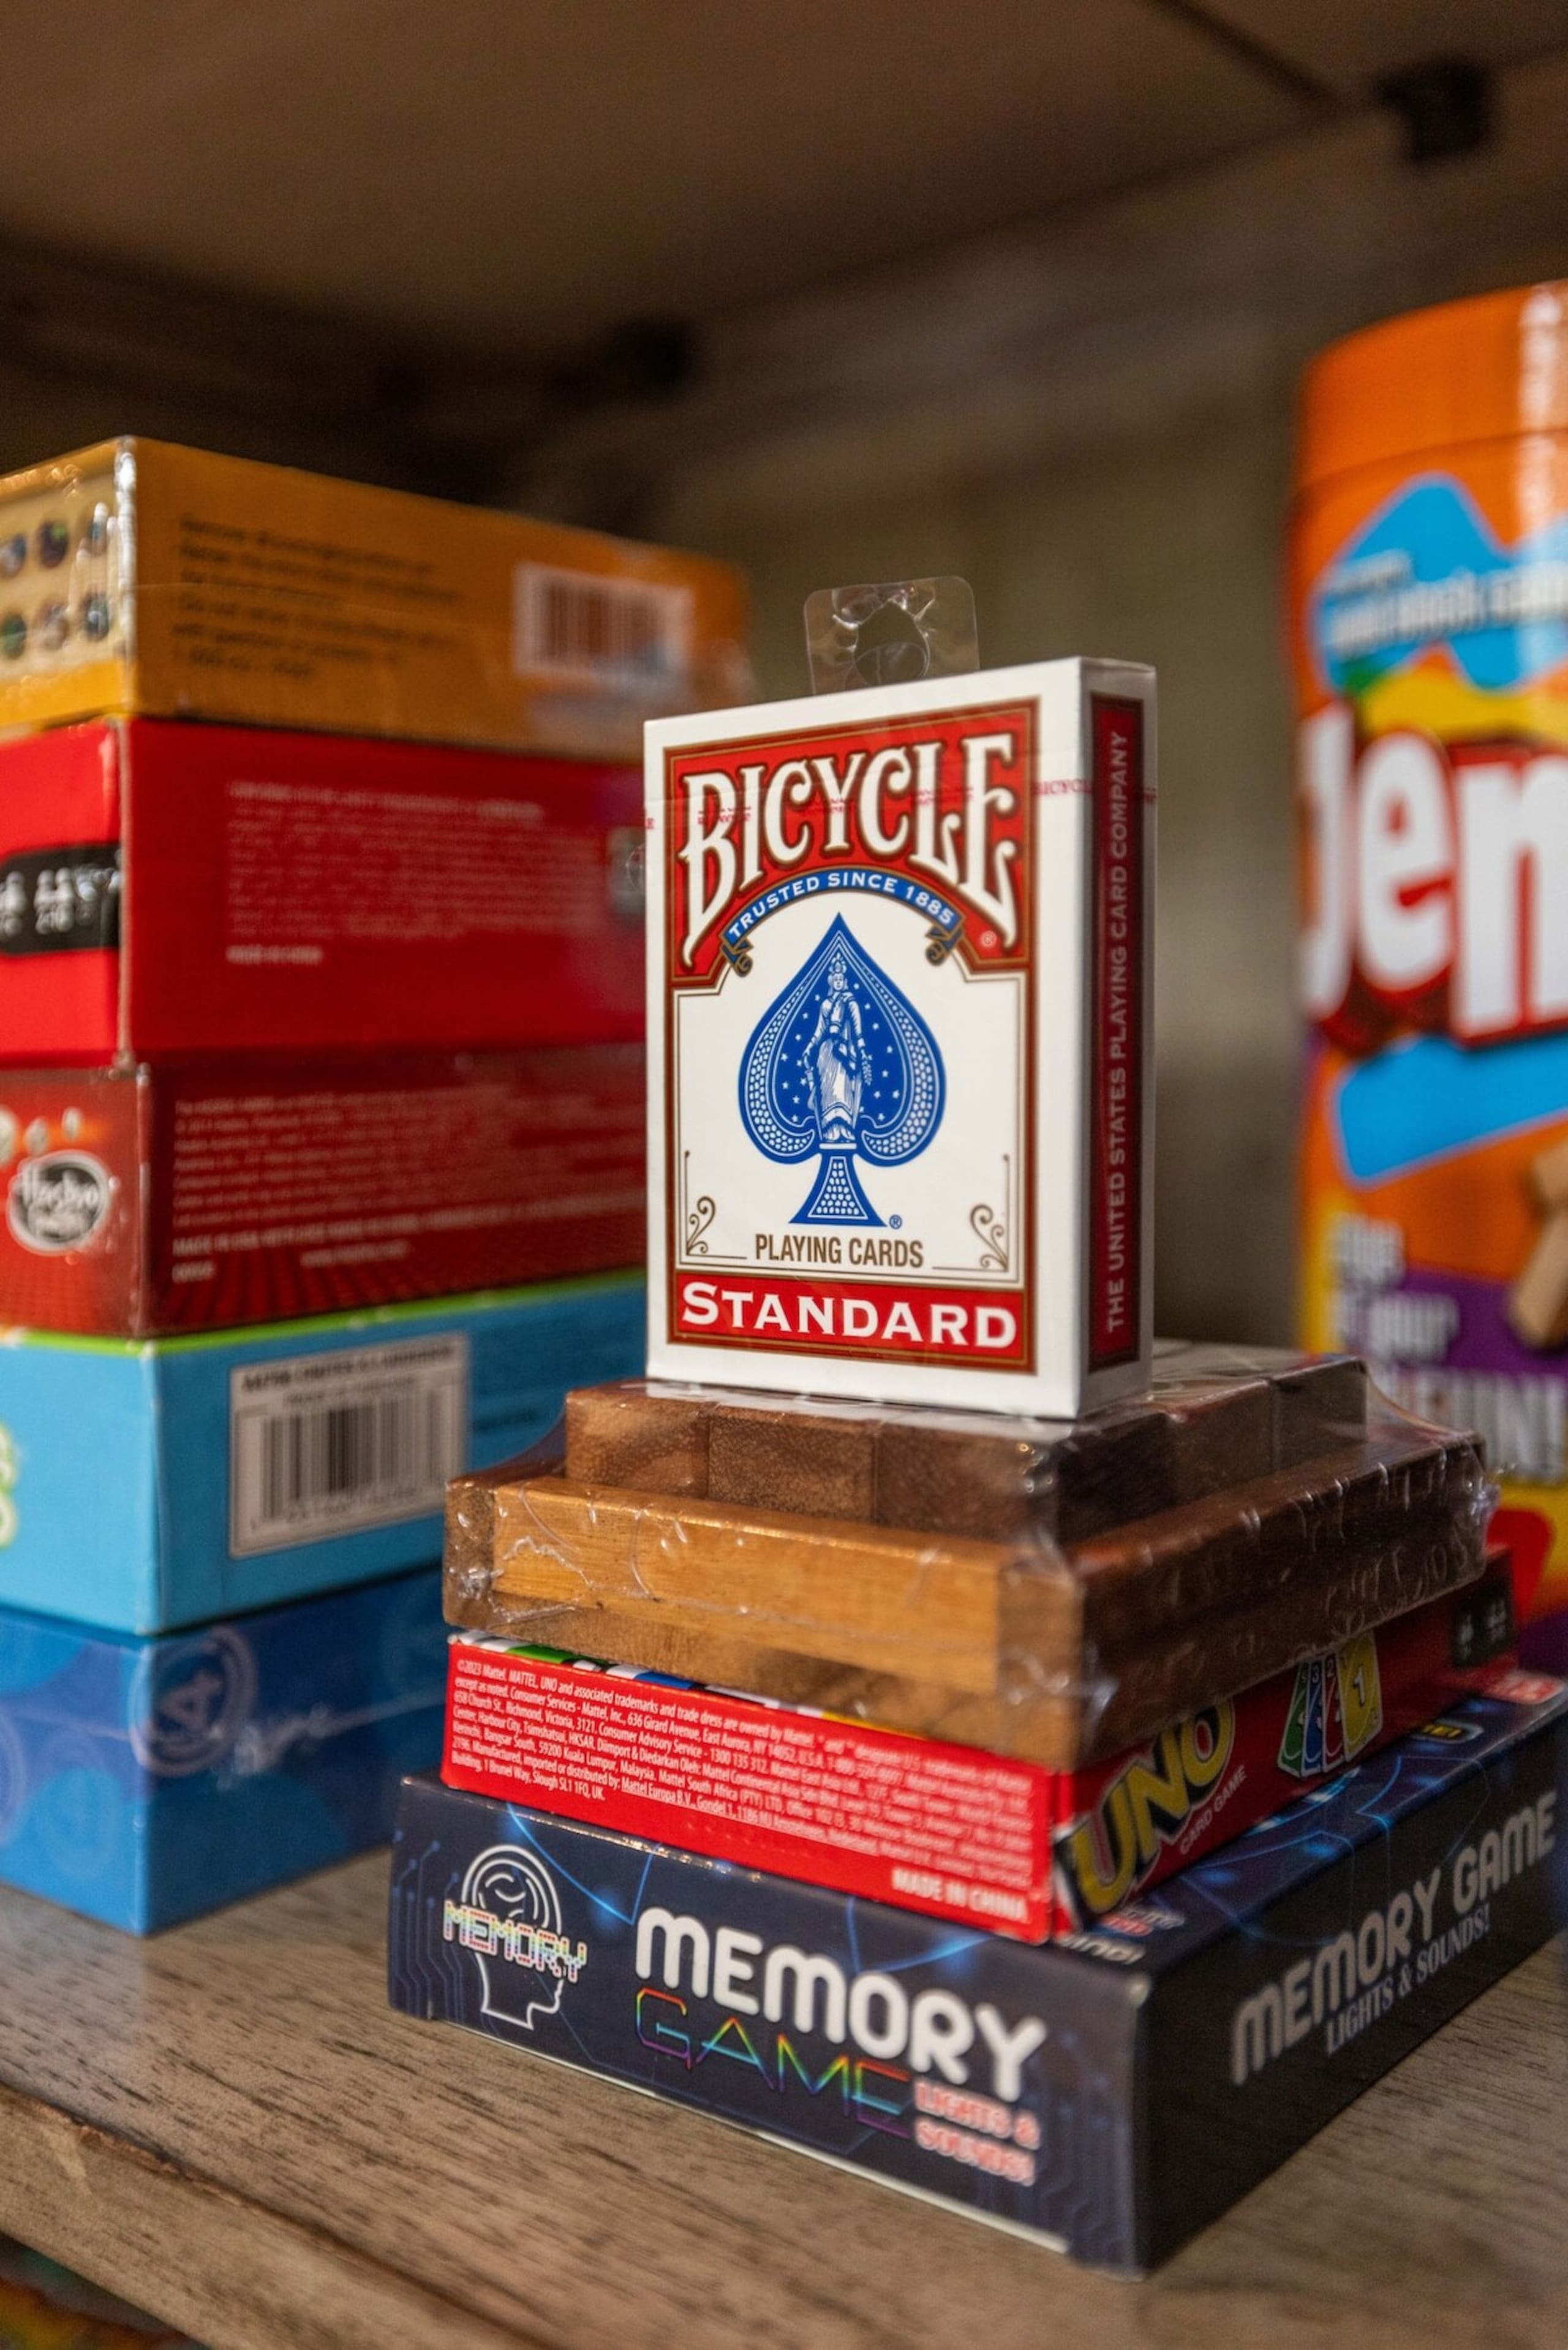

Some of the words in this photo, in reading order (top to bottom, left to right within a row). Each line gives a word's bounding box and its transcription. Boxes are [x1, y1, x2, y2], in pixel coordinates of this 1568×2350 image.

[1112, 731, 1128, 858] COMPANY
[679, 733, 1017, 967] BICYCLE
[728, 875, 820, 939] TRUSTED
[827, 872, 897, 893] SINCE
[905, 885, 956, 924] 1885
[1111, 865, 1128, 939] CARD
[1110, 945, 1127, 1059] PLAYING
[1109, 1067, 1126, 1163] STATES
[755, 1234, 842, 1264] PLAYING
[849, 1238, 924, 1269] CARDS
[1108, 1173, 1126, 1271] UNITED
[681, 1282, 1017, 1350] STANDARD
[1107, 1279, 1125, 1332] THE
[508, 1668, 538, 1690] MATTEL,
[540, 1675, 557, 1691] UNO
[558, 1679, 573, 1694] and
[574, 1682, 613, 1703] associated
[614, 1691, 658, 1713] trademarks
[659, 1701, 676, 1717] and
[677, 1705, 699, 1723] trade
[700, 1710, 722, 1728] dress
[724, 1718, 737, 1731] are
[739, 1718, 769, 1739] owned
[769, 1725, 782, 1744] by
[510, 1685, 546, 1706] Consumer
[546, 1693, 576, 1712] Services
[581, 1701, 608, 1722] Mattel,
[627, 1711, 643, 1728] 636
[643, 1715, 668, 1733] Girard
[669, 1720, 701, 1743] Avenue,
[702, 1728, 720, 1745] East
[576, 1716, 597, 1734] 3121.
[598, 1721, 637, 1744] Consumer
[638, 1730, 672, 1754] Advisory
[673, 1738, 702, 1759] Service
[710, 1747, 731, 1766] 1300
[732, 1751, 748, 1770] 135
[538, 1740, 562, 1758] 59200
[564, 1746, 585, 1763] Kuala
[586, 1751, 619, 1774] Lumpur,
[620, 1759, 657, 1783] Malaysia.
[658, 1769, 685, 1788] Mattel
[687, 1775, 711, 1794] South
[713, 1781, 738, 1801] Africa
[557, 1764, 565, 1774] or
[567, 1762, 607, 1785] distributed
[622, 1776, 647, 1794] Mattel
[649, 1783, 676, 1804] Europa
[559, 1777, 572, 1792] SL1
[631, 1745, 638, 1760] &
[639, 1747, 679, 1770] Diedarkan
[703, 1762, 729, 1782] Mattel
[1070, 1699, 1234, 1914] UNO
[1180, 1812, 1212, 1856] CARD
[1213, 1766, 1249, 1817] GAME
[443, 1900, 587, 1982] MEMORY
[1232, 1867, 1442, 2084] MEMORY
[1452, 1790, 1556, 1915] GAME
[635, 1906, 1047, 2102] MEMORY
[1327, 1976, 1393, 2055] LIGHTS
[1397, 1968, 1412, 1998] &
[1417, 1903, 1491, 1986] SOUNDS!
[635, 1987, 911, 2140] GAME
